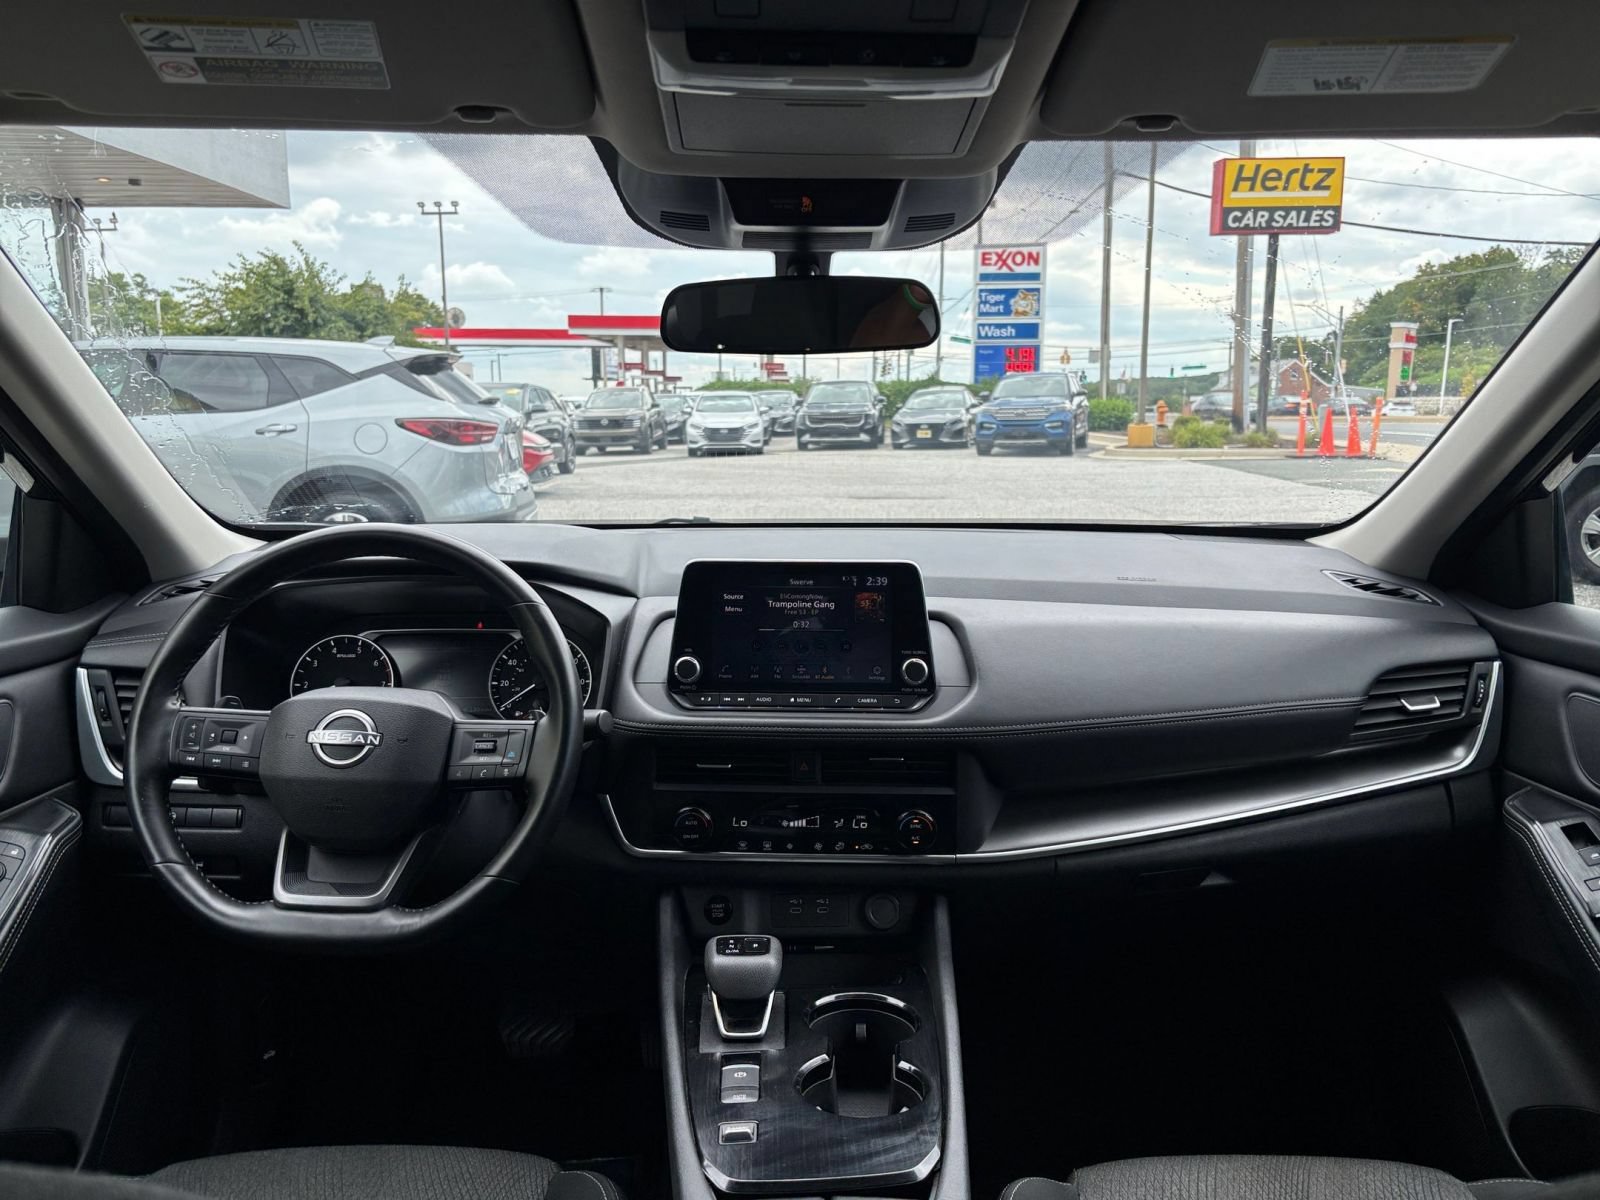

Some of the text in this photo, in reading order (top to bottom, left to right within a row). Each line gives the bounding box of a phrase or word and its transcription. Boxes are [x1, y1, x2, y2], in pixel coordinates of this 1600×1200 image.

[206, 59, 378, 71] AIRBAG WARNING
[1231, 163, 1337, 192] Hertz
[1227, 208, 1335, 228] CAR SALES
[980, 249, 1040, 272] EXXON
[979, 292, 1006, 303] Tiger
[979, 303, 1004, 313] Mart
[979, 326, 1016, 337] Wash
[789, 578, 814, 586] Swerve
[865, 576, 888, 586] 2:39
[725, 605, 743, 613] Menu
[768, 600, 835, 610] Trampoline Gang
[792, 621, 810, 629] 0:32
[313, 659, 318, 667] 3
[373, 659, 379, 667] 6
[303, 681, 309, 689] 2
[500, 679, 509, 687] 20
[309, 732, 380, 745] NISSAN
[732, 816, 748, 827] Lo
[852, 818, 868, 829] Lo
